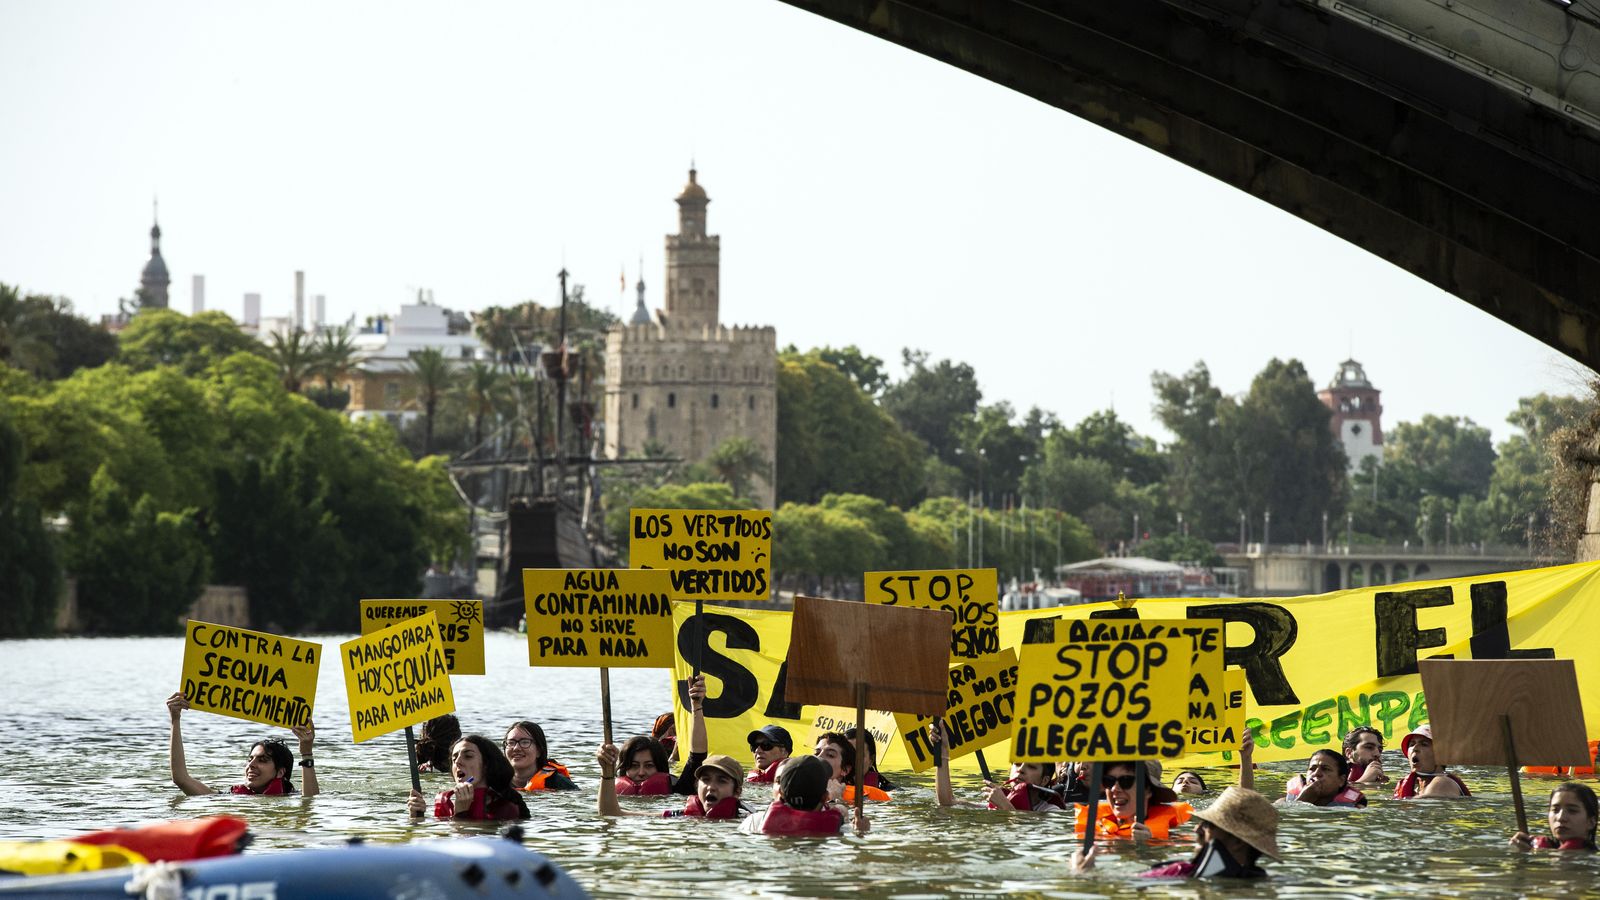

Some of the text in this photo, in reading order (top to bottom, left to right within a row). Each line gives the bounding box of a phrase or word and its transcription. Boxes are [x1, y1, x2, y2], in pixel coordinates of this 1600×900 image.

[634, 514, 772, 540] LOS VERTIDOS
[663, 541, 740, 562] NO SON
[564, 571, 619, 592] AGUA
[879, 573, 974, 605] STOP
[366, 606, 429, 620] QUEREMOS
[534, 592, 672, 617] CONTAMINADA
[561, 619, 584, 633] NO
[1374, 580, 1556, 679] EL
[192, 625, 316, 664] CONTRA LA
[349, 636, 401, 670] MANGO
[538, 636, 649, 658] PARA NADA
[199, 652, 288, 690] SEQUIA
[383, 644, 446, 696] SEQUÍA
[1053, 641, 1168, 682] STOP
[972, 676, 997, 696] NO
[1028, 681, 1152, 721] POZOS
[184, 679, 312, 728] DECRECIMIENTO
[356, 686, 446, 731] PARA MAÑANA
[815, 716, 834, 731] SED
